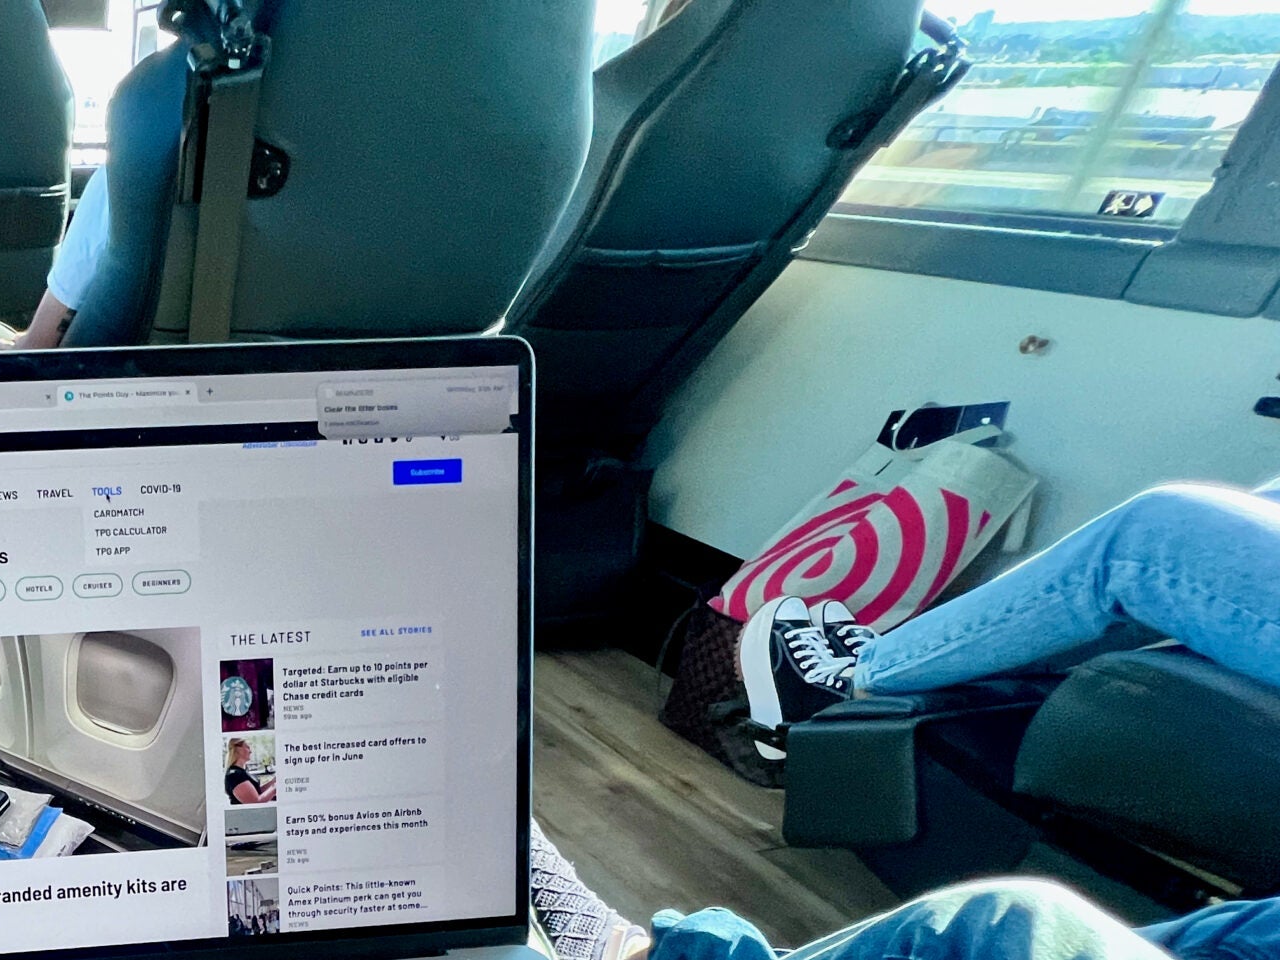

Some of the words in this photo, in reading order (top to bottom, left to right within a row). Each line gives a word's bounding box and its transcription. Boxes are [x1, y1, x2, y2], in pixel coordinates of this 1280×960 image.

[37, 489, 73, 499] TRAVEL
[92, 486, 122, 497] TOOLS
[140, 484, 181, 495] COVID-19
[94, 508, 145, 519] CARDMATCH
[95, 528, 112, 537] TPG
[113, 526, 167, 536] CALCULATOR
[96, 547, 113, 556] TPG
[114, 547, 131, 555] APP
[25, 584, 53, 593] HOTELS
[83, 581, 113, 590] CRUISES
[142, 578, 181, 588] BEGINNERS
[361, 629, 377, 637] SEE
[379, 628, 395, 636] ALL
[397, 626, 433, 635] STORIES
[230, 633, 256, 647] THE
[261, 630, 312, 645] LATEST
[282, 665, 326, 678] Targeted:
[327, 664, 348, 674] Earn
[349, 666, 361, 675] up
[362, 663, 372, 672] to
[373, 662, 383, 671] 10
[384, 661, 412, 672] points
[413, 661, 428, 671] per
[282, 679, 308, 689] dollar
[309, 679, 319, 687] at
[320, 676, 365, 687] Starbucks
[366, 675, 386, 684] with
[387, 673, 419, 685] eligible
[283, 691, 310, 701] Chase
[311, 690, 338, 700] credit
[339, 689, 364, 698] cards
[284, 743, 301, 752] The
[302, 741, 322, 751] best
[323, 739, 366, 750] increased
[367, 738, 388, 748] card
[389, 736, 416, 746] offers
[417, 736, 427, 745] to
[284, 755, 303, 766] sign
[304, 756, 316, 765] up
[317, 753, 330, 763] for
[332, 753, 341, 762] in
[342, 752, 364, 762] June
[286, 814, 306, 824] Earn
[307, 813, 327, 823] 50%
[328, 812, 354, 822] bonus
[356, 810, 380, 820] Avios
[381, 810, 393, 818] on
[394, 808, 422, 817] Airbnb
[286, 827, 309, 839] stays
[311, 826, 327, 835] and
[329, 823, 382, 836] experiences
[383, 821, 400, 831] this
[401, 819, 428, 829] month
[56, 880, 122, 899] amenity
[126, 878, 157, 895] kits
[160, 879, 187, 892] are
[287, 885, 311, 896] Quick
[313, 883, 343, 893] Points:
[345, 881, 363, 891] This
[365, 878, 416, 890] little-known
[288, 897, 312, 907] Amex
[314, 894, 352, 905] Platinum
[353, 893, 372, 905] perk
[374, 892, 390, 901] can
[391, 891, 406, 901] get
[407, 889, 422, 899] you
[288, 908, 322, 919] through
[323, 905, 358, 917] security
[359, 903, 385, 914] faster
[387, 903, 396, 911] at
